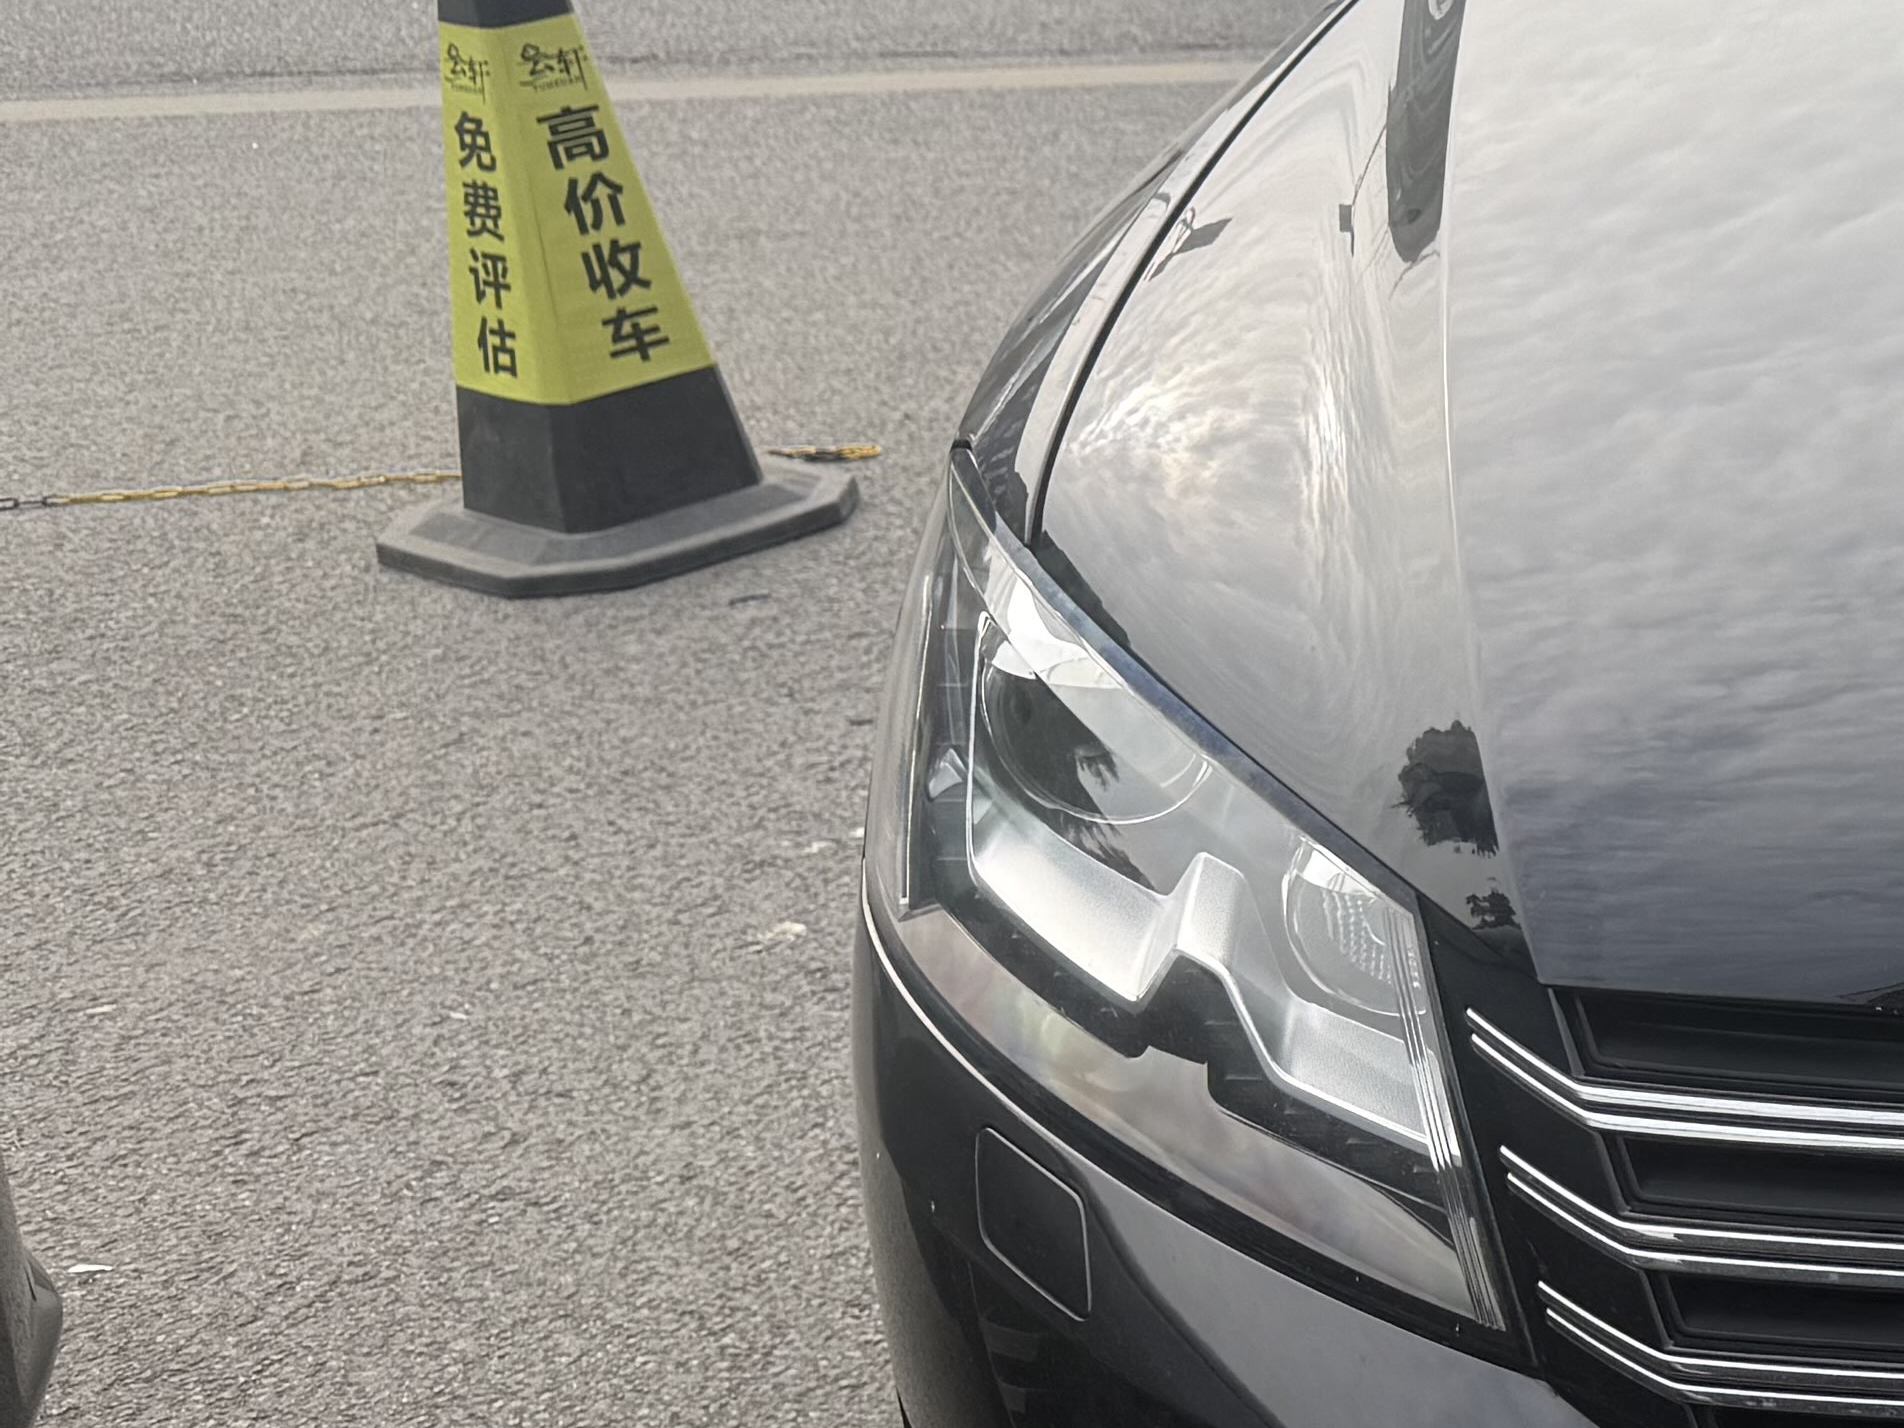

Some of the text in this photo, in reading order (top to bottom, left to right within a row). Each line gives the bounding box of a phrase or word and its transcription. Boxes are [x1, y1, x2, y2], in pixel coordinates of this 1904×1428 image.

[453, 110, 519, 378] 免费评估
[536, 104, 670, 363] 高价收车
